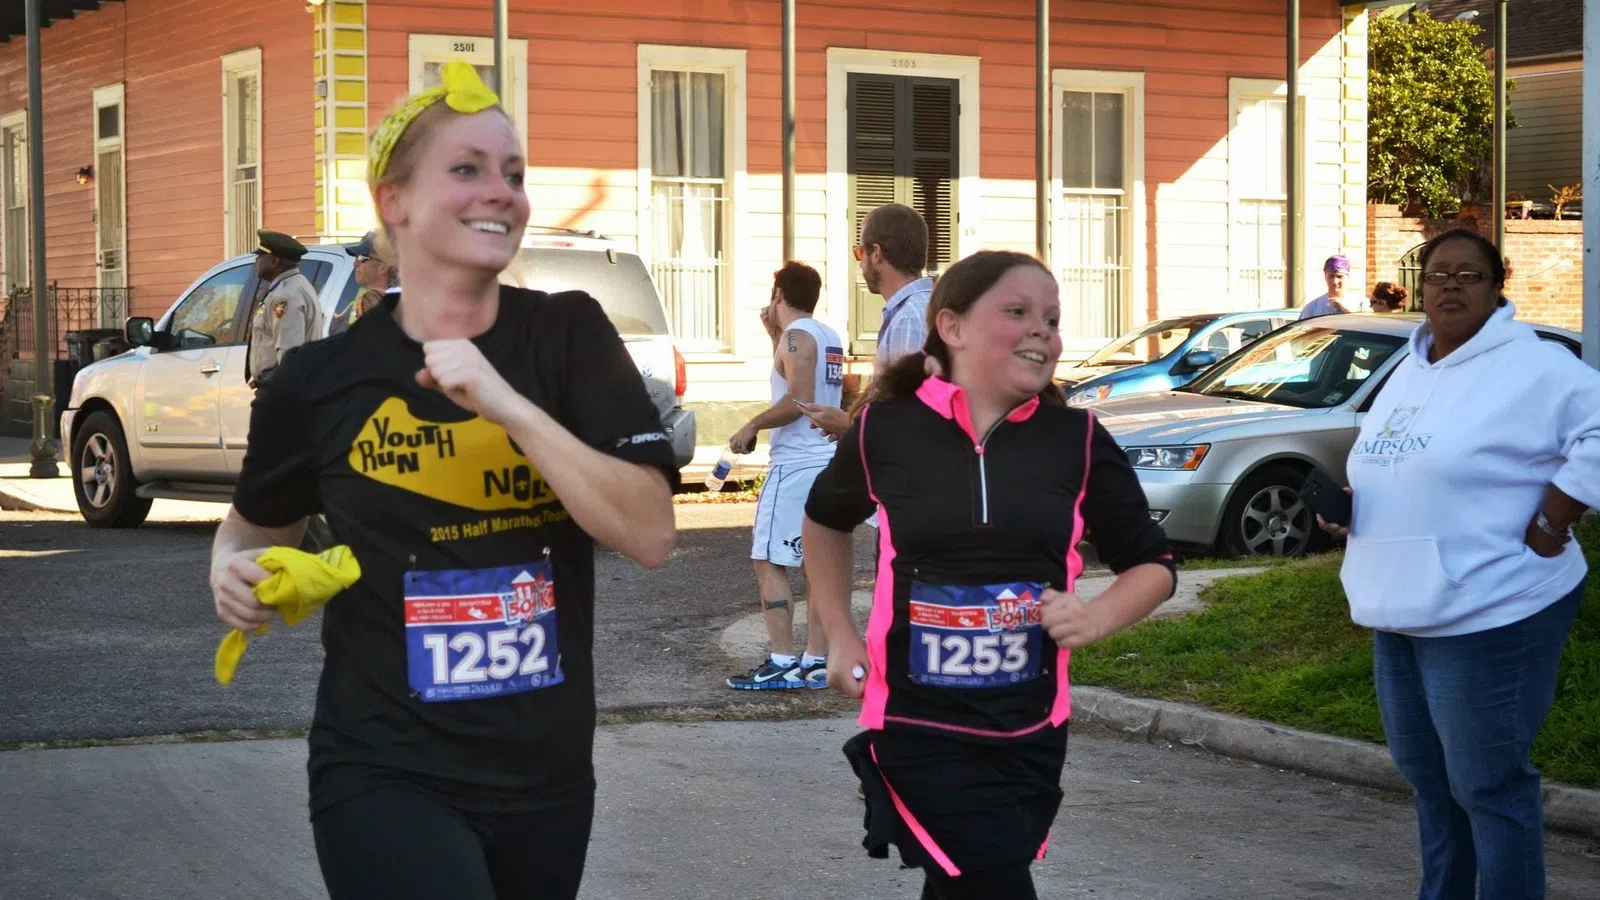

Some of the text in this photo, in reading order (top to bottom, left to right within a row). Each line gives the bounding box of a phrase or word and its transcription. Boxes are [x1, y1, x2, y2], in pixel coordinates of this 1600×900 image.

[453, 43, 475, 52] 2501
[372, 416, 456, 459] YOUTH
[1352, 435, 1434, 456] IMPSON
[358, 440, 420, 475] RUN
[483, 464, 552, 503] NOL
[430, 524, 460, 542] 2015
[462, 519, 489, 538] Half
[423, 623, 549, 685] 1252
[921, 632, 1029, 676] 1253
